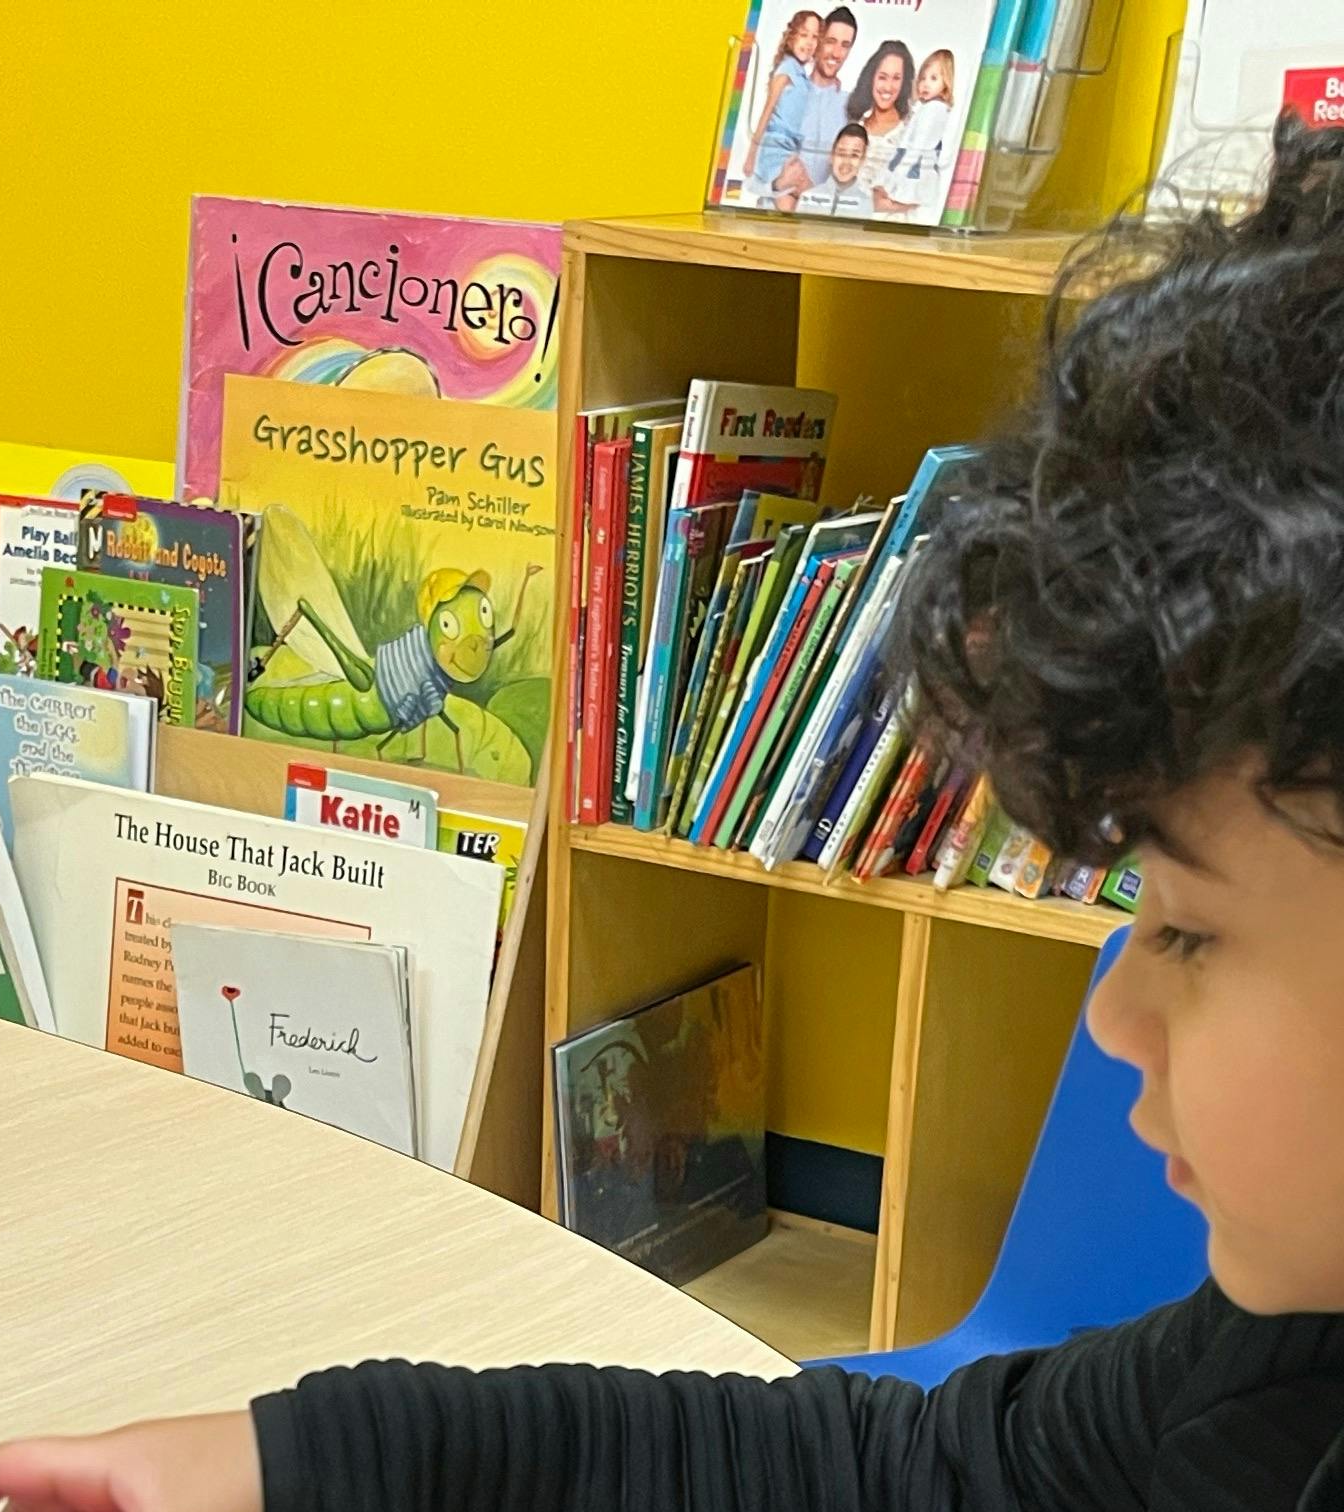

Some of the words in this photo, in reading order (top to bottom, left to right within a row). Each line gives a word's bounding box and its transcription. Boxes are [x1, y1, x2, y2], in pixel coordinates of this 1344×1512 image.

[719, 407, 757, 438] First
[762, 408, 825, 440] Readers
[254, 414, 468, 478] Grasshopper
[480, 441, 546, 488] Gus
[626, 451, 647, 513] JAMES
[426, 486, 460, 506] Pam
[467, 491, 531, 516] Schiller
[461, 511, 474, 532] by
[477, 514, 507, 532] Carol
[21, 526, 51, 546] Play
[2, 542, 51, 563] Amelia
[155, 541, 180, 568] and
[182, 543, 228, 582] Coyote
[619, 522, 642, 627] HERRIOT'S
[615, 643, 633, 700] Treasury
[16, 714, 39, 733] the
[615, 702, 629, 724] for
[21, 742, 47, 757] and
[52, 744, 74, 763] the
[611, 727, 629, 784] Children
[320, 794, 400, 839] Katie
[114, 813, 150, 844] The
[155, 821, 221, 858] House
[226, 835, 275, 868] That
[278, 845, 325, 878] Jack
[331, 854, 385, 890] Built
[461, 832, 500, 855] TER
[123, 949, 162, 972] Rodney
[155, 979, 173, 993] the
[140, 1015, 161, 1032] Jack
[117, 1034, 149, 1051] added
[151, 1040, 162, 1053] to
